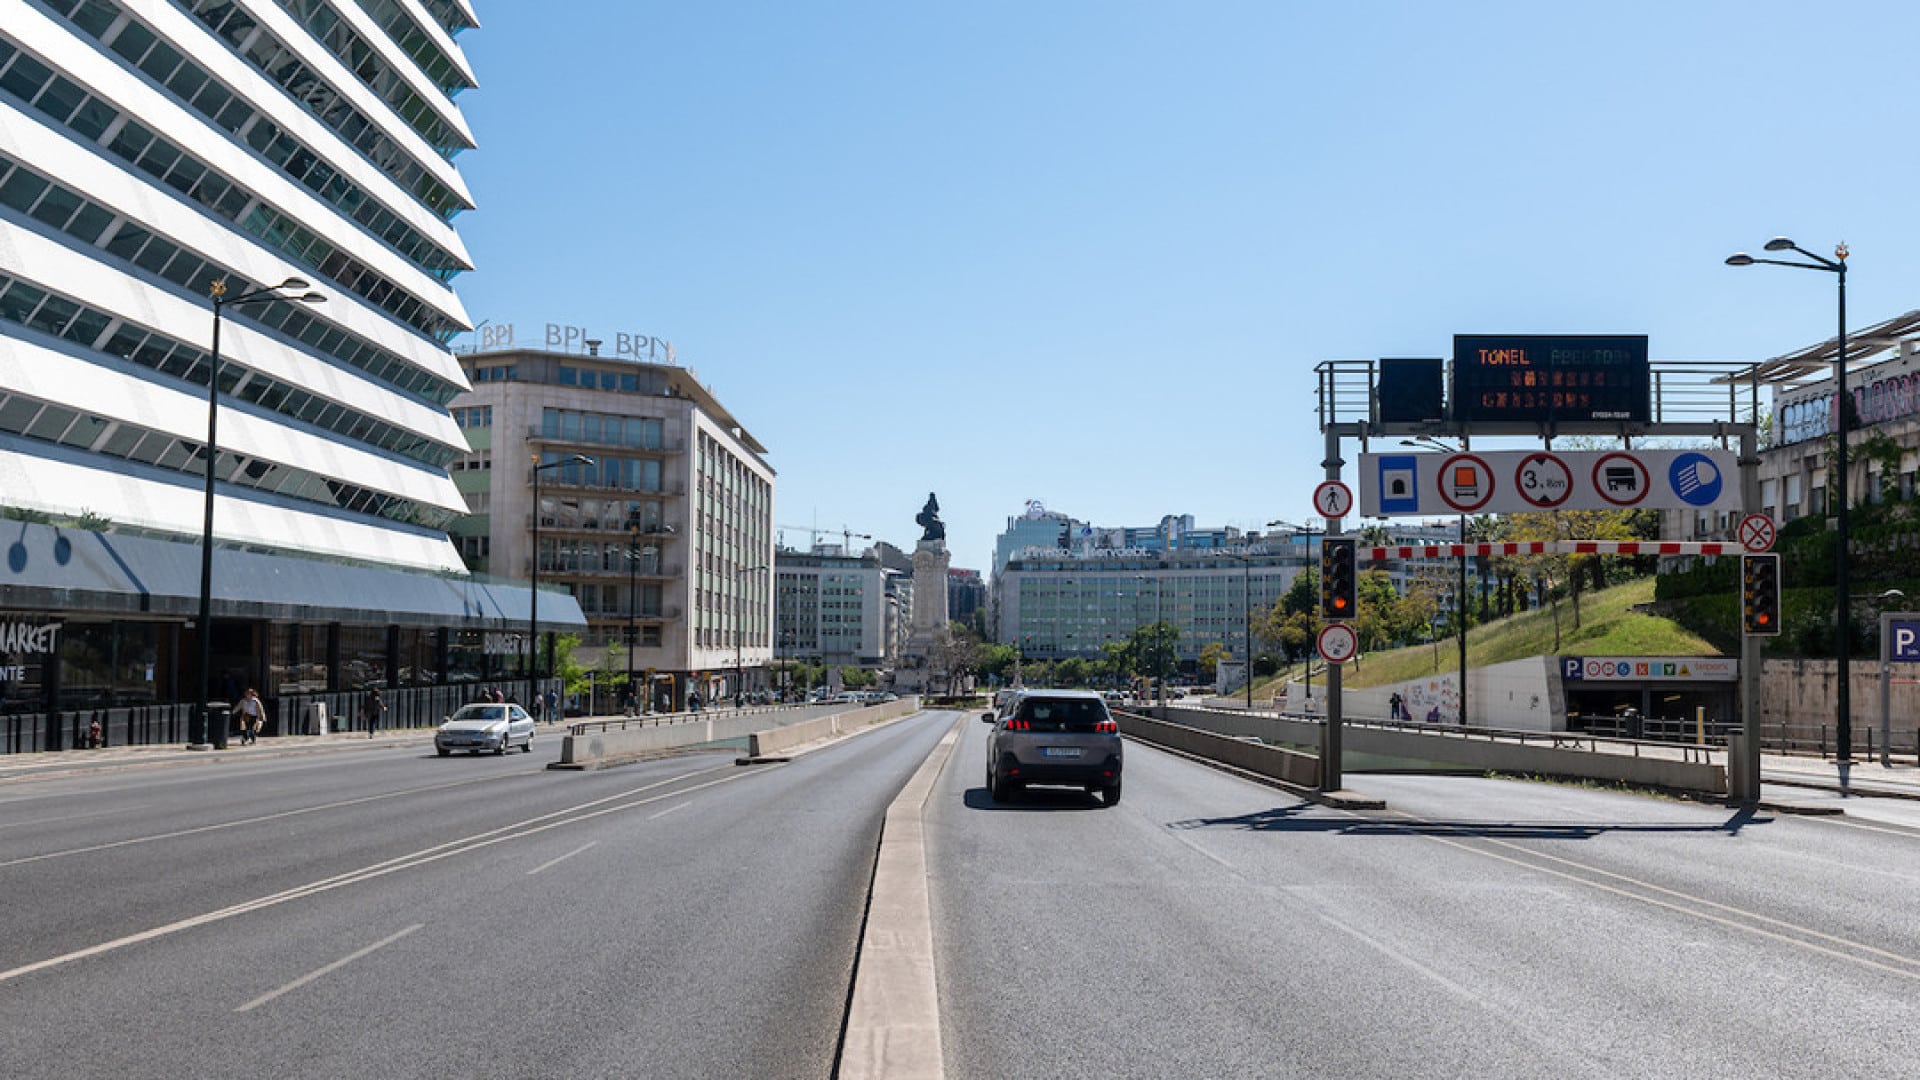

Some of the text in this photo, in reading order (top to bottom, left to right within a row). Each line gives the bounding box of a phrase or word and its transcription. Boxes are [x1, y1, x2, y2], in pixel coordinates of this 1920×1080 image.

[482, 324, 513, 347] BPI
[546, 323, 586, 348] BPI
[1896, 627, 1915, 656] P
[1567, 660, 1578, 677] P
